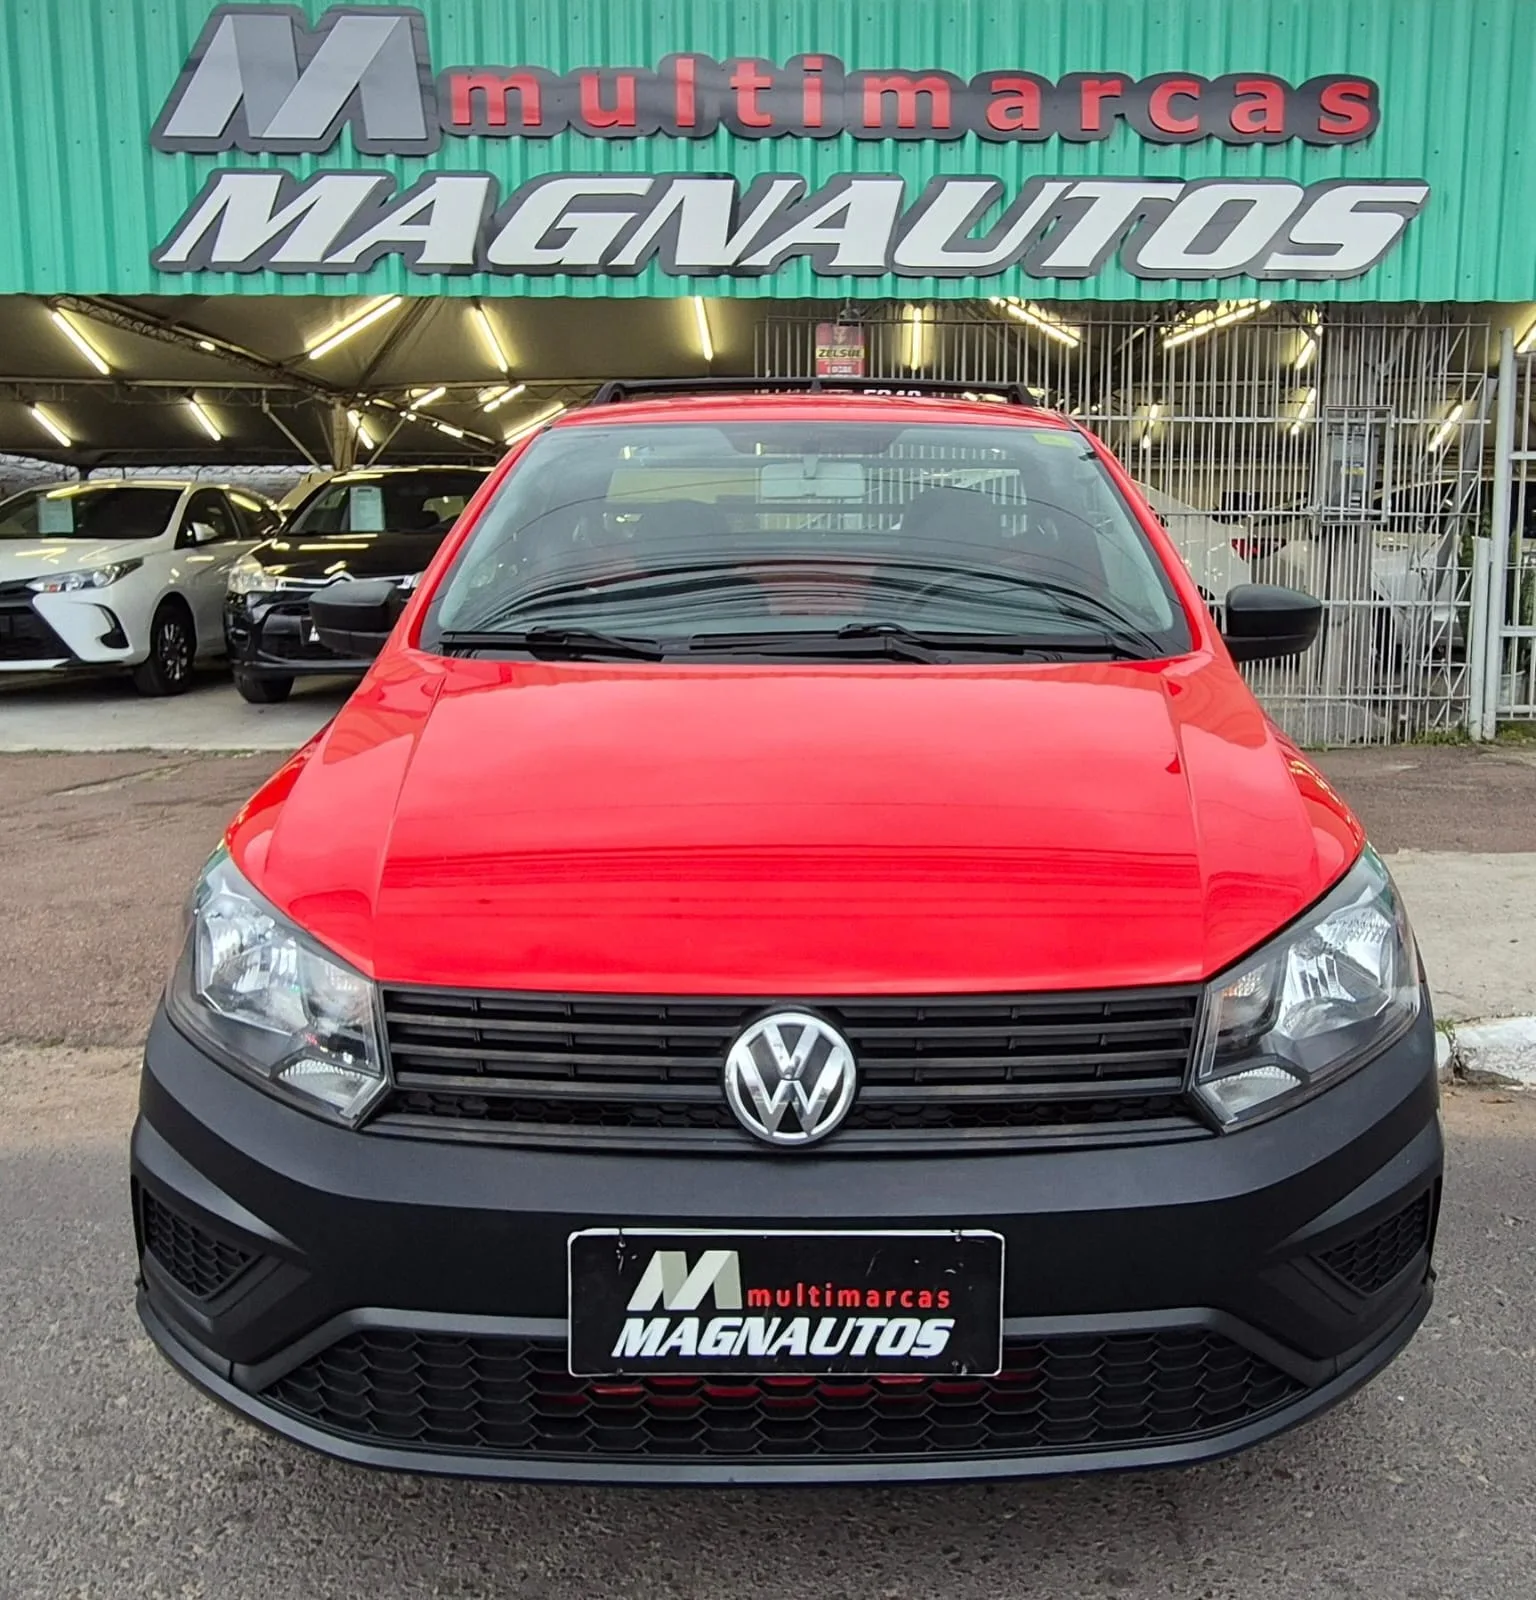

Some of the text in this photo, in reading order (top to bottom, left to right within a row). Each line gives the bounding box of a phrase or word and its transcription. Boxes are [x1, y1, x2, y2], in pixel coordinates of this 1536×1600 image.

[449, 55, 1373, 136] multimarcas
[158, 173, 1430, 274] MAGNAUTOS
[746, 1282, 951, 1309] multimarcas
[611, 1317, 955, 1358] MAGNAUTOS
